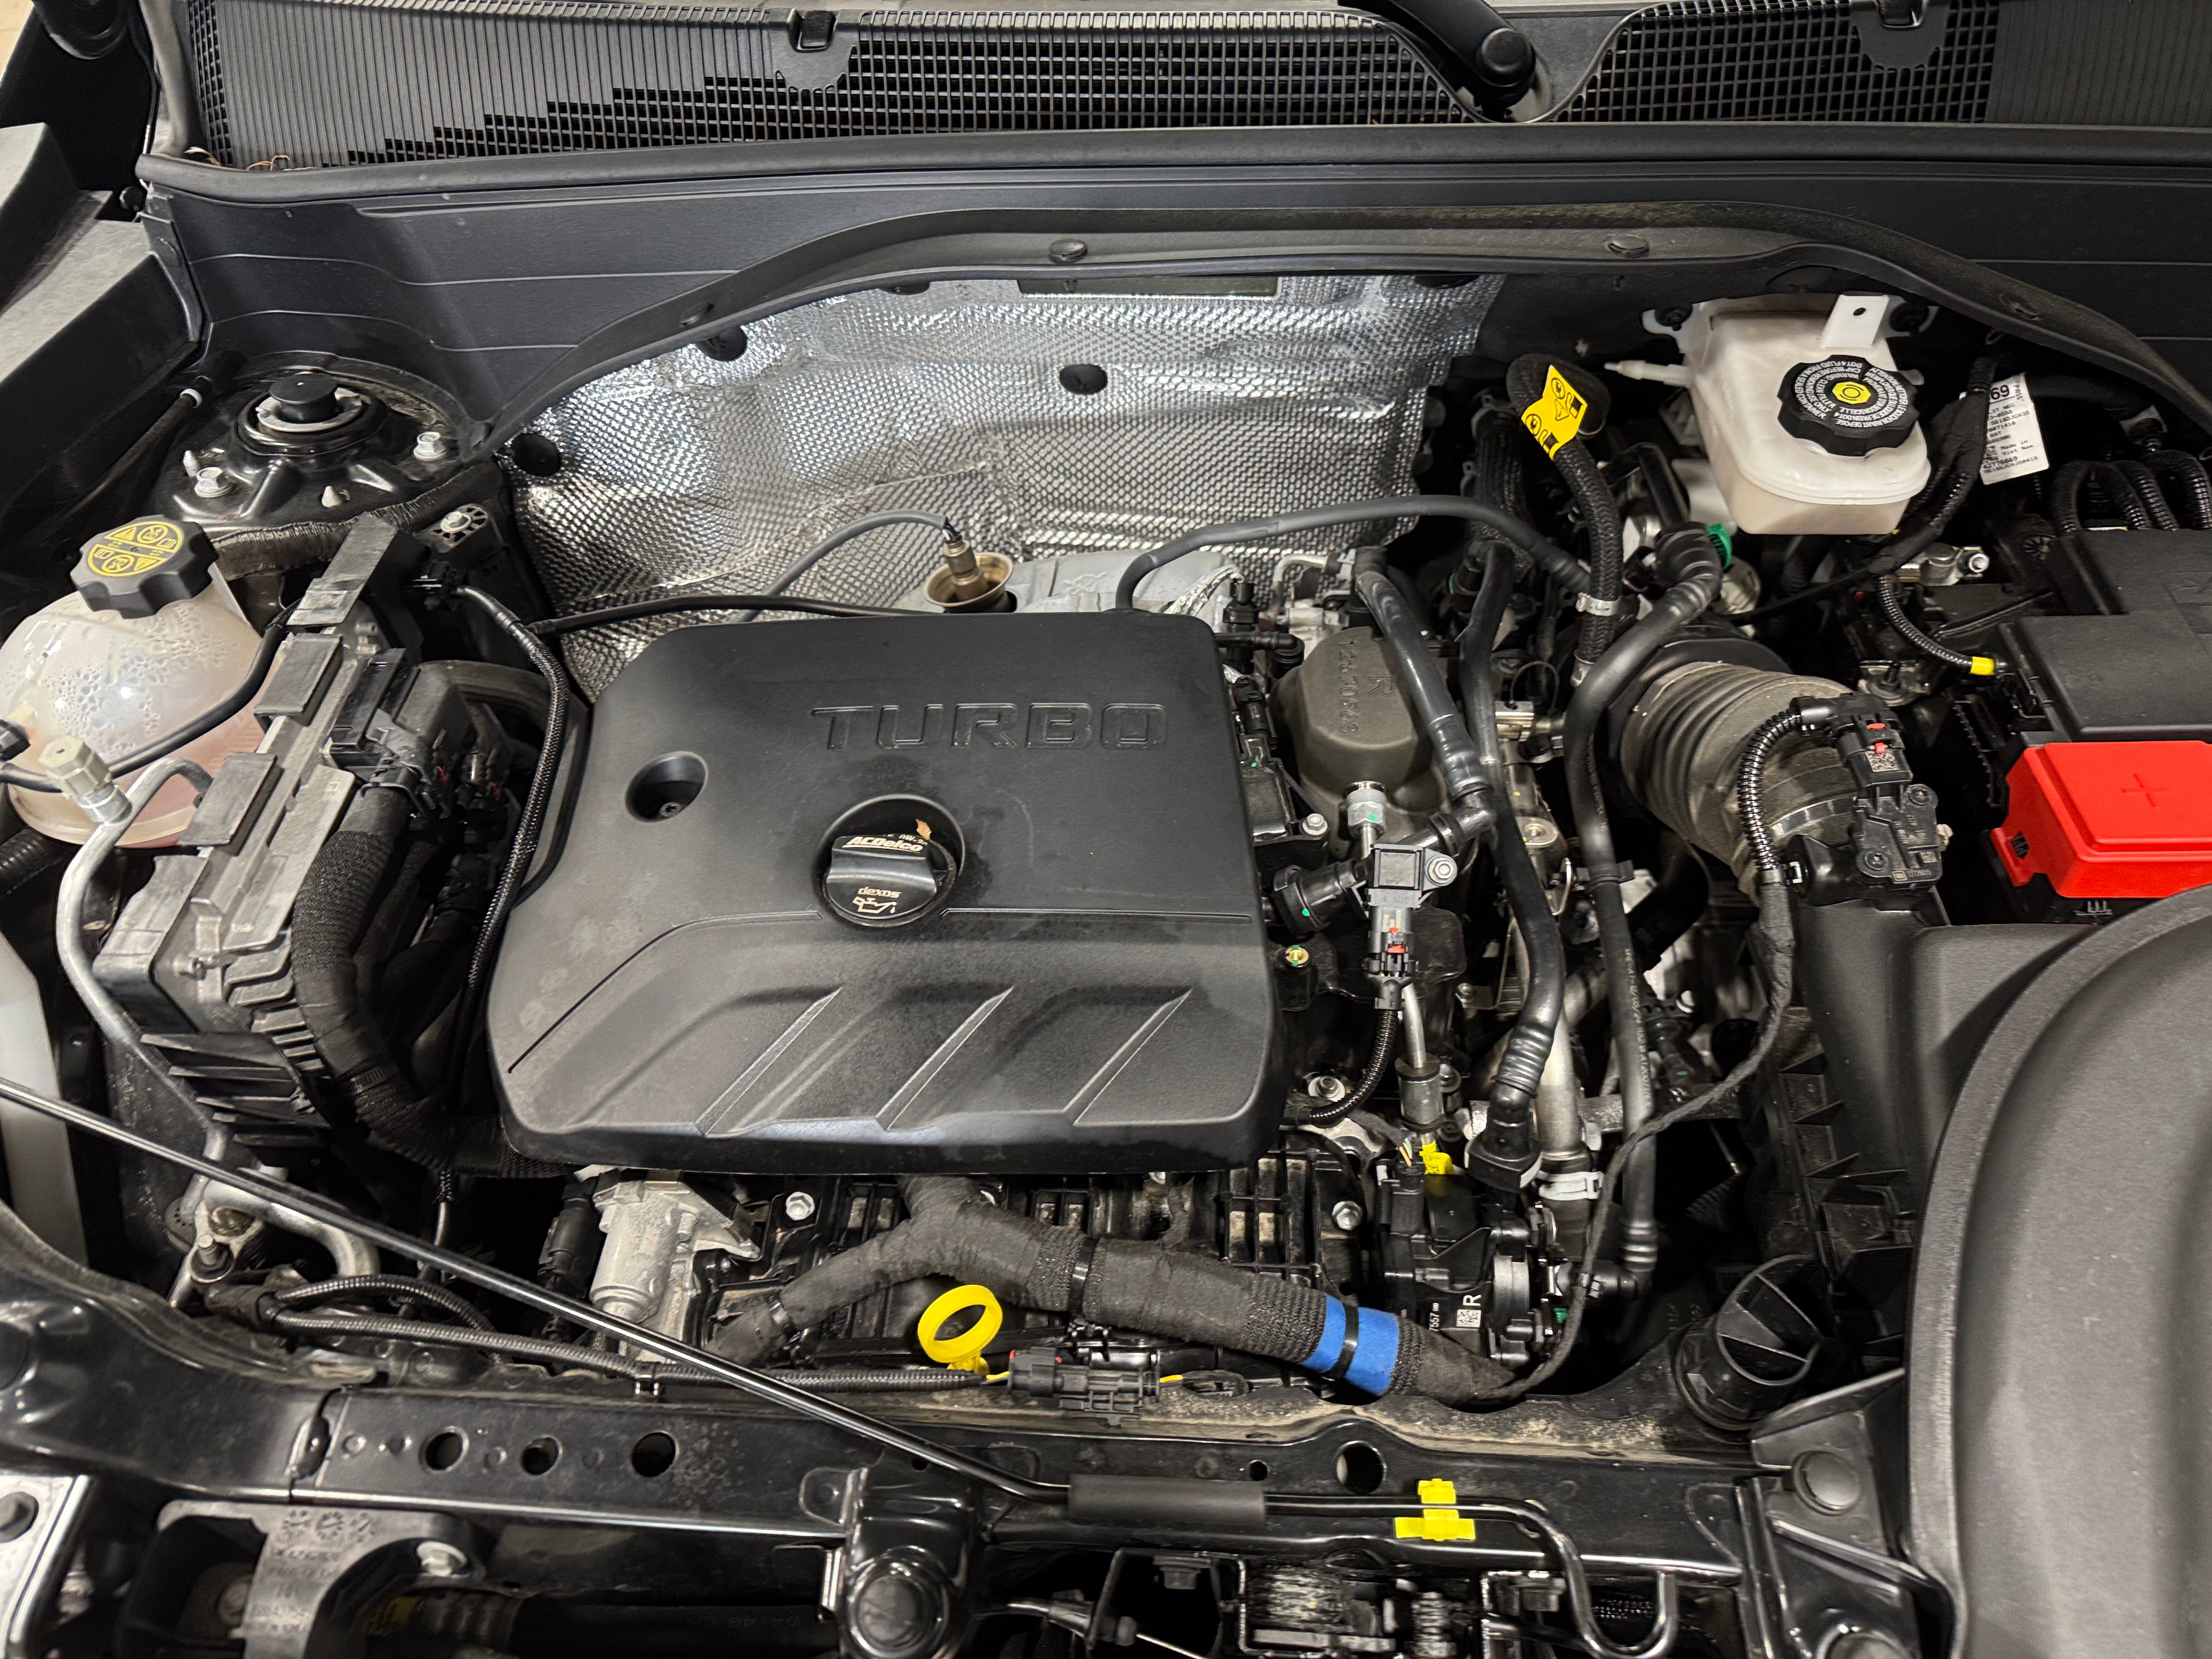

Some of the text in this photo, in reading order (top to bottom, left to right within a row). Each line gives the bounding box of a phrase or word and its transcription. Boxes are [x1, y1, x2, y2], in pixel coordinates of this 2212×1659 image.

[1802, 364, 1822, 375] FROM
[1817, 367, 1844, 376] BEFORE
[1795, 376, 1807, 393] SEALED
[1815, 379, 1829, 392] CLEAN
[1806, 393, 1819, 402] USE
[1816, 393, 1837, 408] FILLER
[1813, 402, 1833, 413] ONLY
[1368, 675, 1393, 695] R
[812, 702, 1167, 750] TURBO
[846, 836, 923, 851] ACDelco
[857, 886, 902, 899] dexos
[1463, 1294, 1481, 1306] R
